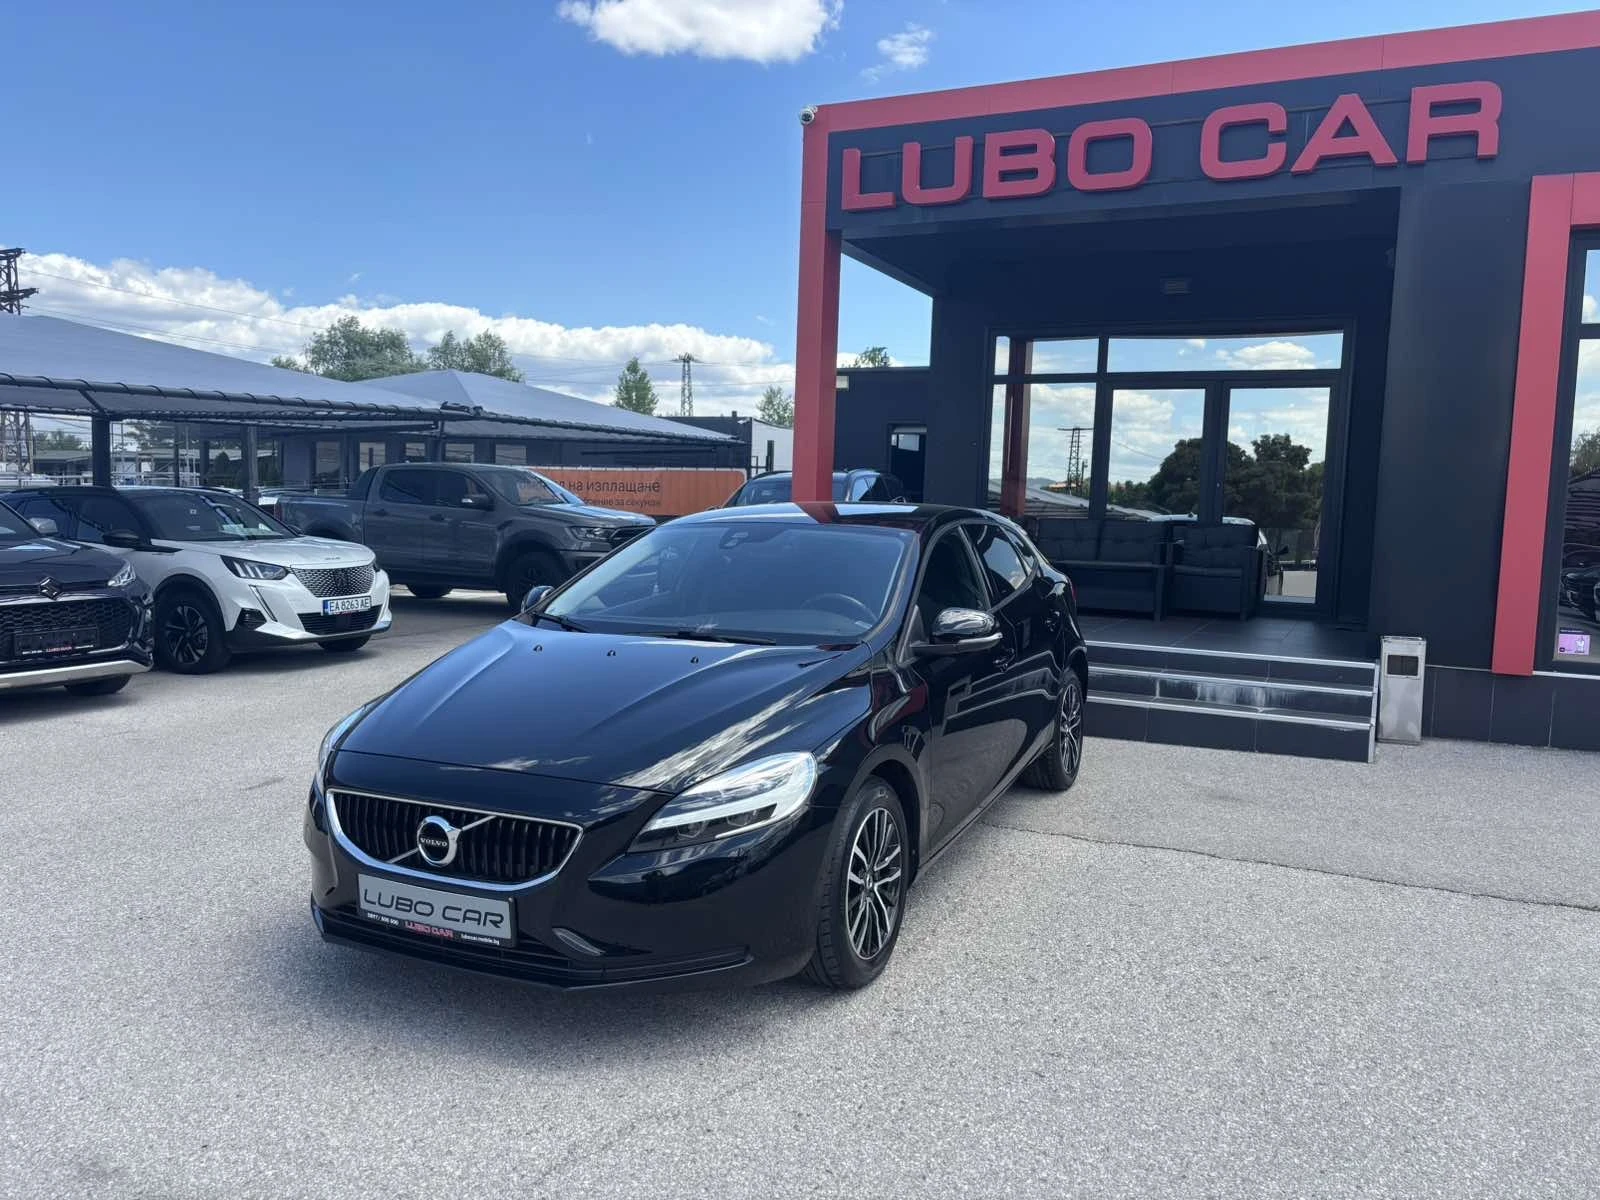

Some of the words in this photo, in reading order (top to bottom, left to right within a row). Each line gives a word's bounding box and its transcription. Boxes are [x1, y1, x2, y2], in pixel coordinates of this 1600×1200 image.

[840, 116, 1153, 212] LUBO
[1198, 80, 1503, 182] CAR
[586, 480, 661, 494] изплащане
[330, 601, 340, 612] EA
[341, 600, 359, 610] 8263
[420, 837, 448, 847] VOLVO
[363, 888, 434, 917] LUBO
[442, 905, 505, 929] CAR
